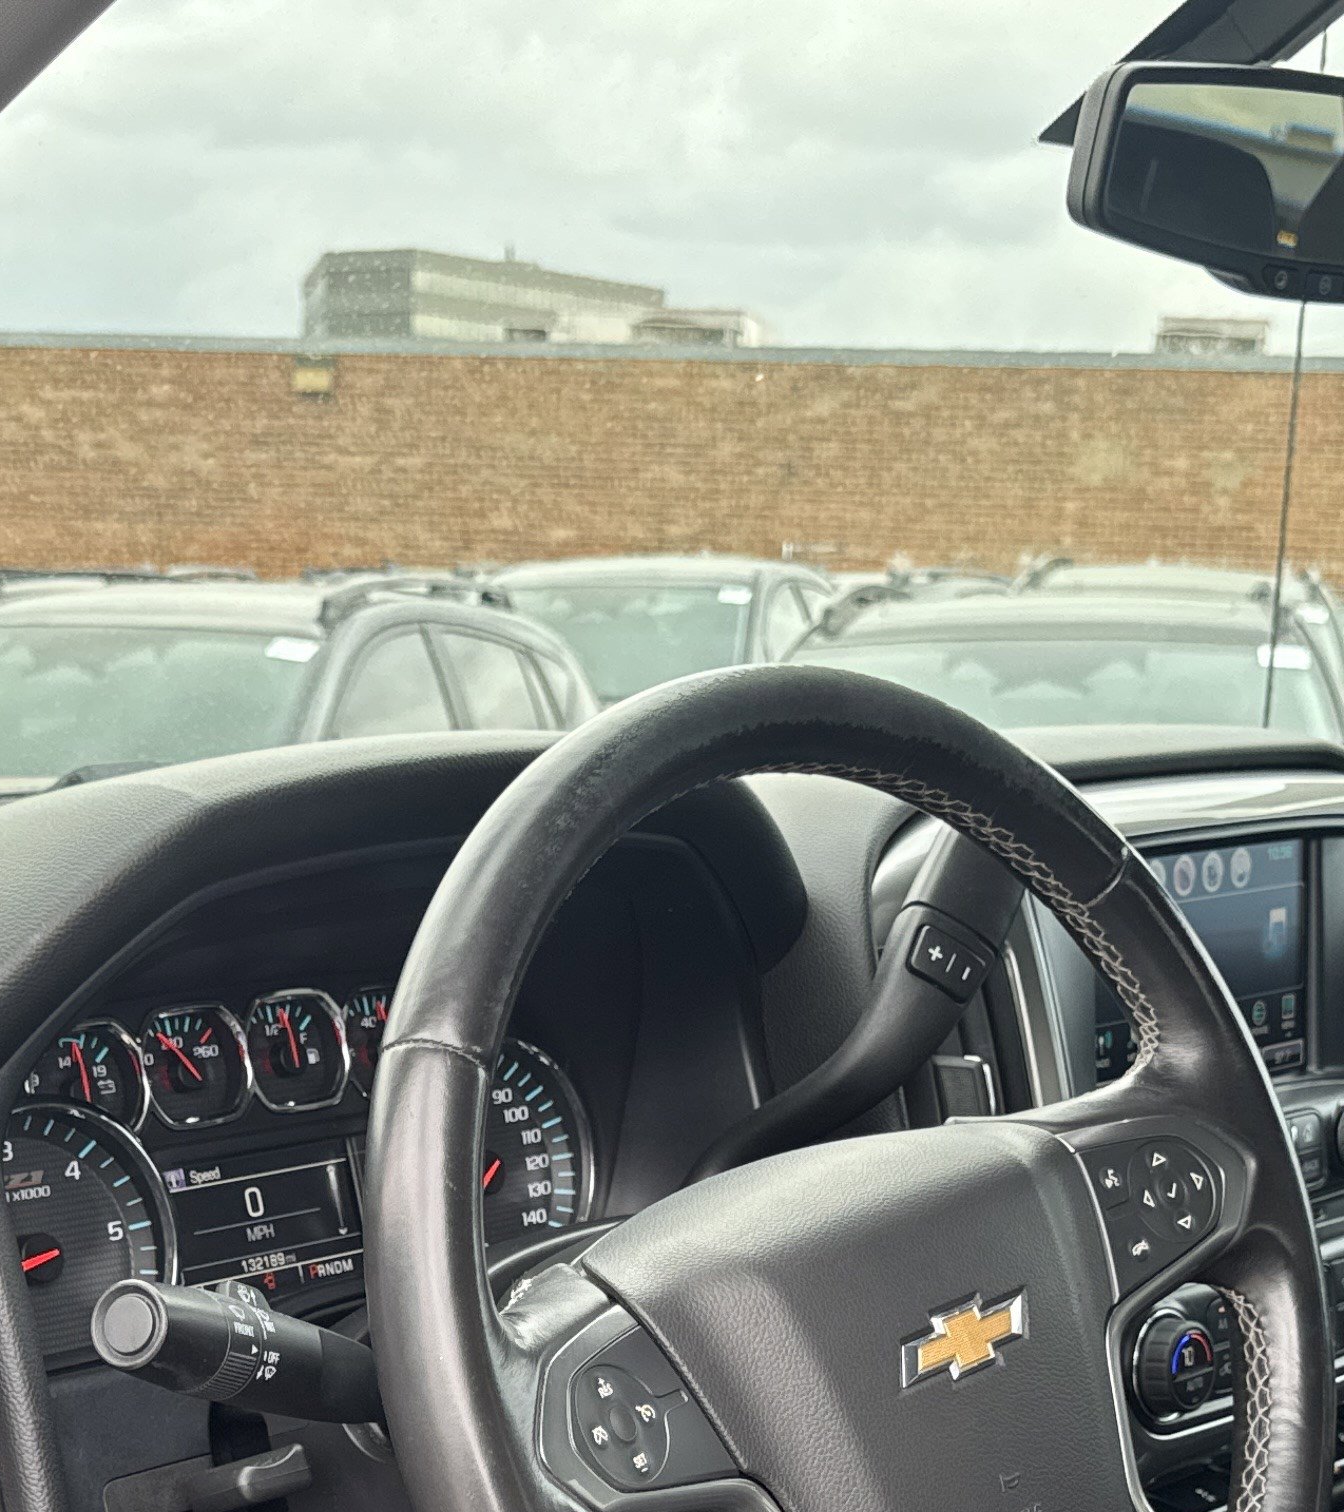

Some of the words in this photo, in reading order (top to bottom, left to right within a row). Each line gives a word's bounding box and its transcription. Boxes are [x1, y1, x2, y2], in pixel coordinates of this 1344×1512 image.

[299, 1032, 308, 1044] F
[192, 1044, 219, 1059] 260
[58, 1056, 72, 1069] 14
[92, 1065, 107, 1078] 19
[492, 1087, 513, 1104] 90
[503, 1105, 529, 1123] 100
[521, 1128, 542, 1145] 110
[2, 1141, 14, 1161] 3
[64, 1160, 81, 1180] 4
[525, 1153, 550, 1171] 120
[188, 1166, 222, 1184] Speed
[527, 1181, 552, 1198] 130
[244, 1186, 265, 1218] 0
[521, 1207, 548, 1226] 140
[107, 1220, 124, 1241] 5
[245, 1223, 276, 1242] MPH
[241, 1252, 286, 1273] 132189
[267, 1351, 280, 1364] OFF
